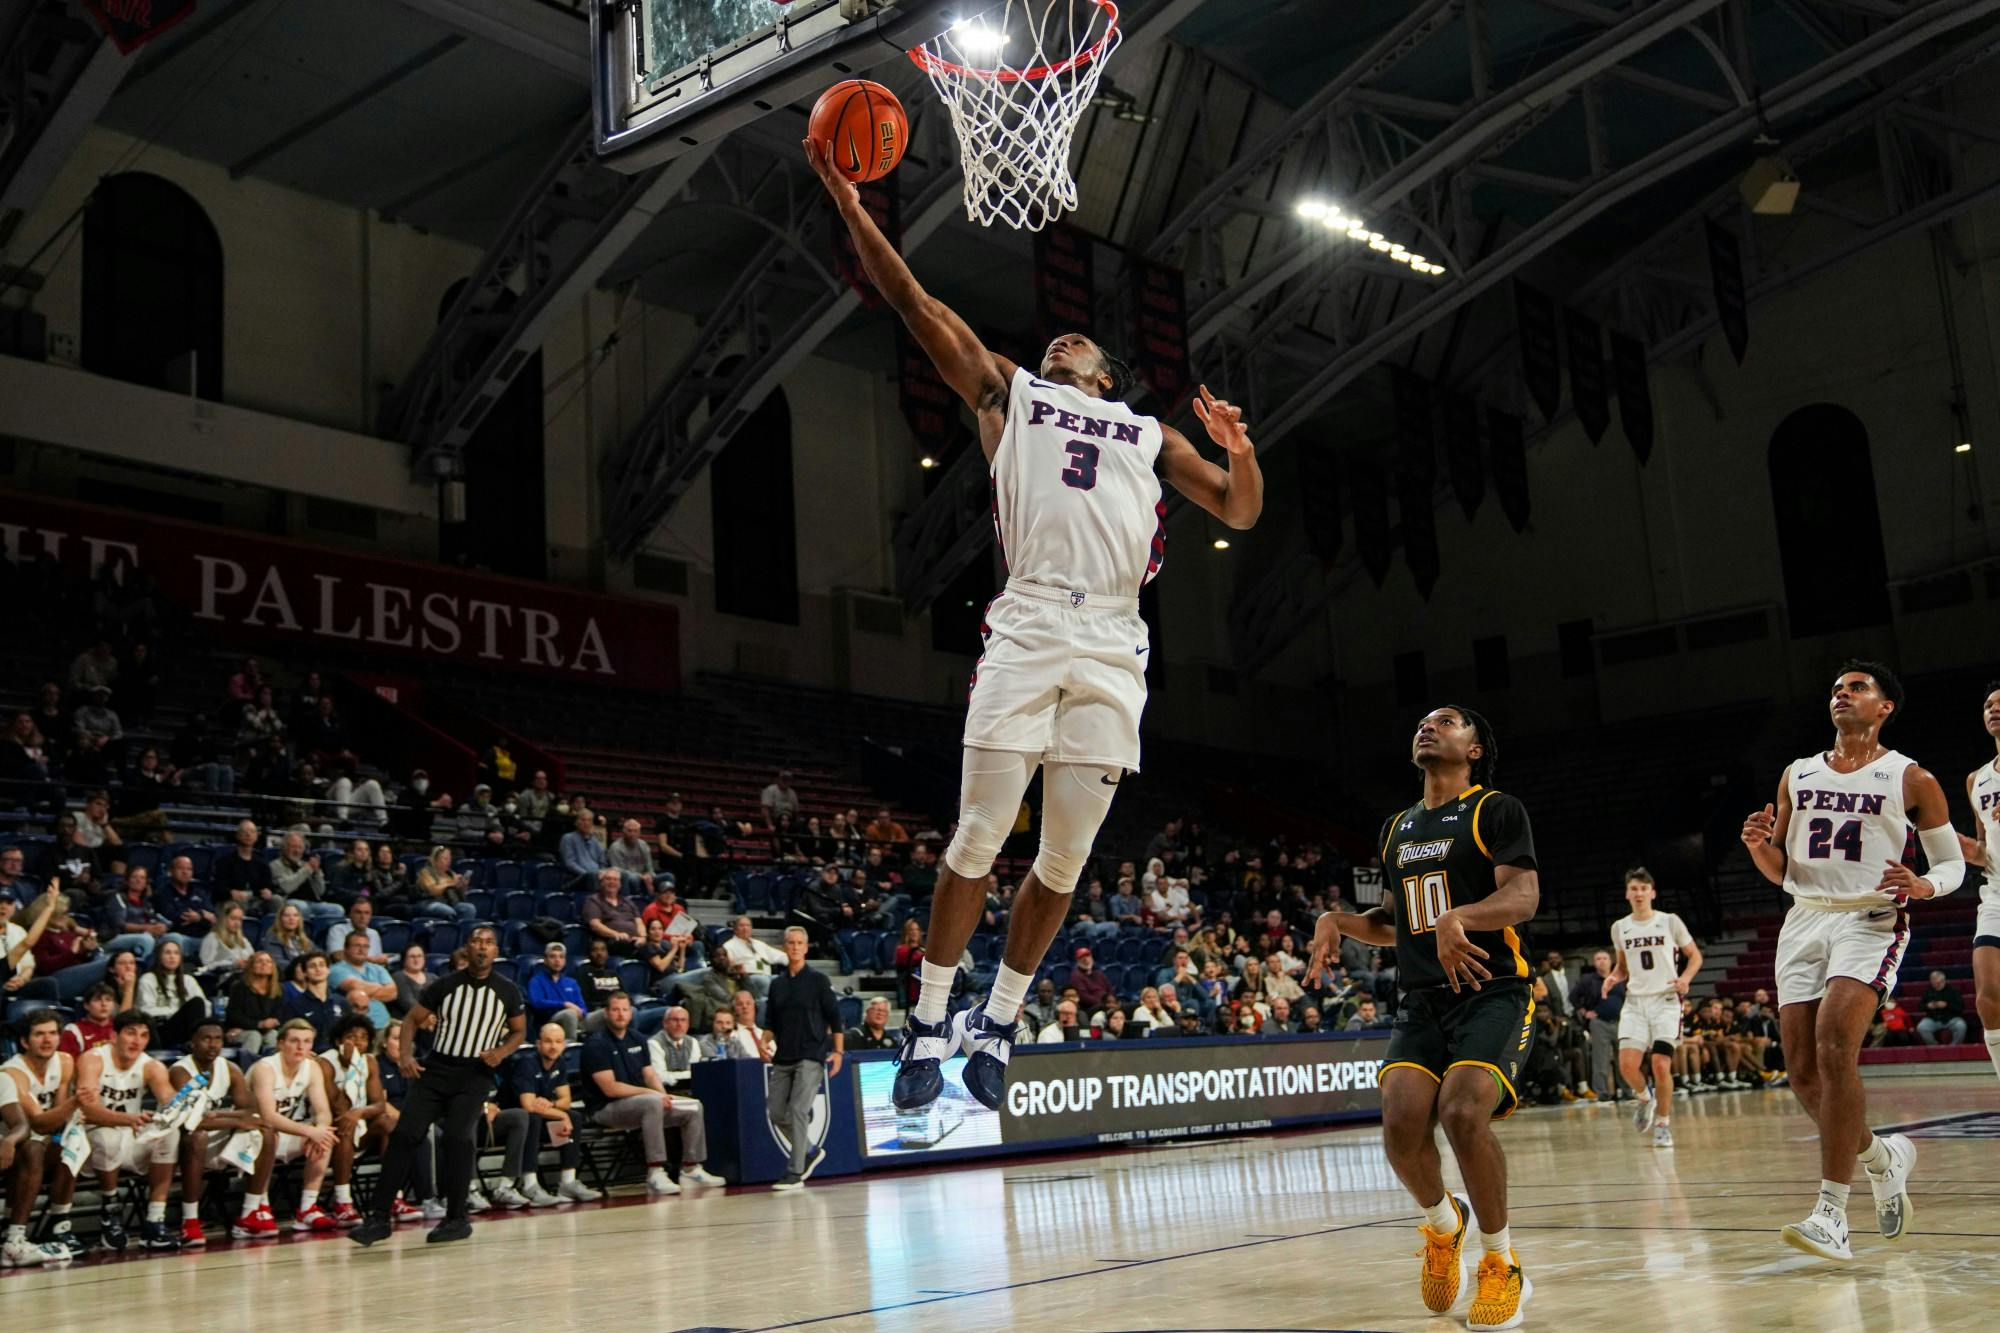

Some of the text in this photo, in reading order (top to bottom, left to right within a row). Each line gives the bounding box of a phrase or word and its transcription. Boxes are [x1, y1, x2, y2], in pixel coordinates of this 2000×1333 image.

[1029, 400, 1142, 446] PENN
[1062, 439, 1100, 491] 3
[194, 555, 616, 676] PALESTRA
[1796, 789, 1886, 815] PENN
[1808, 818, 1863, 862] 24
[1402, 871, 1452, 935] 10
[1624, 936, 1665, 950] PENN
[1640, 950, 1654, 971] 0
[1007, 1077, 1104, 1117] GROUP
[1106, 1064, 1314, 1108] TRANSPORTATION
[1097, 1119, 1273, 1143] WELCOME TO MACQUARIE COURT AT THE PALESTRA
